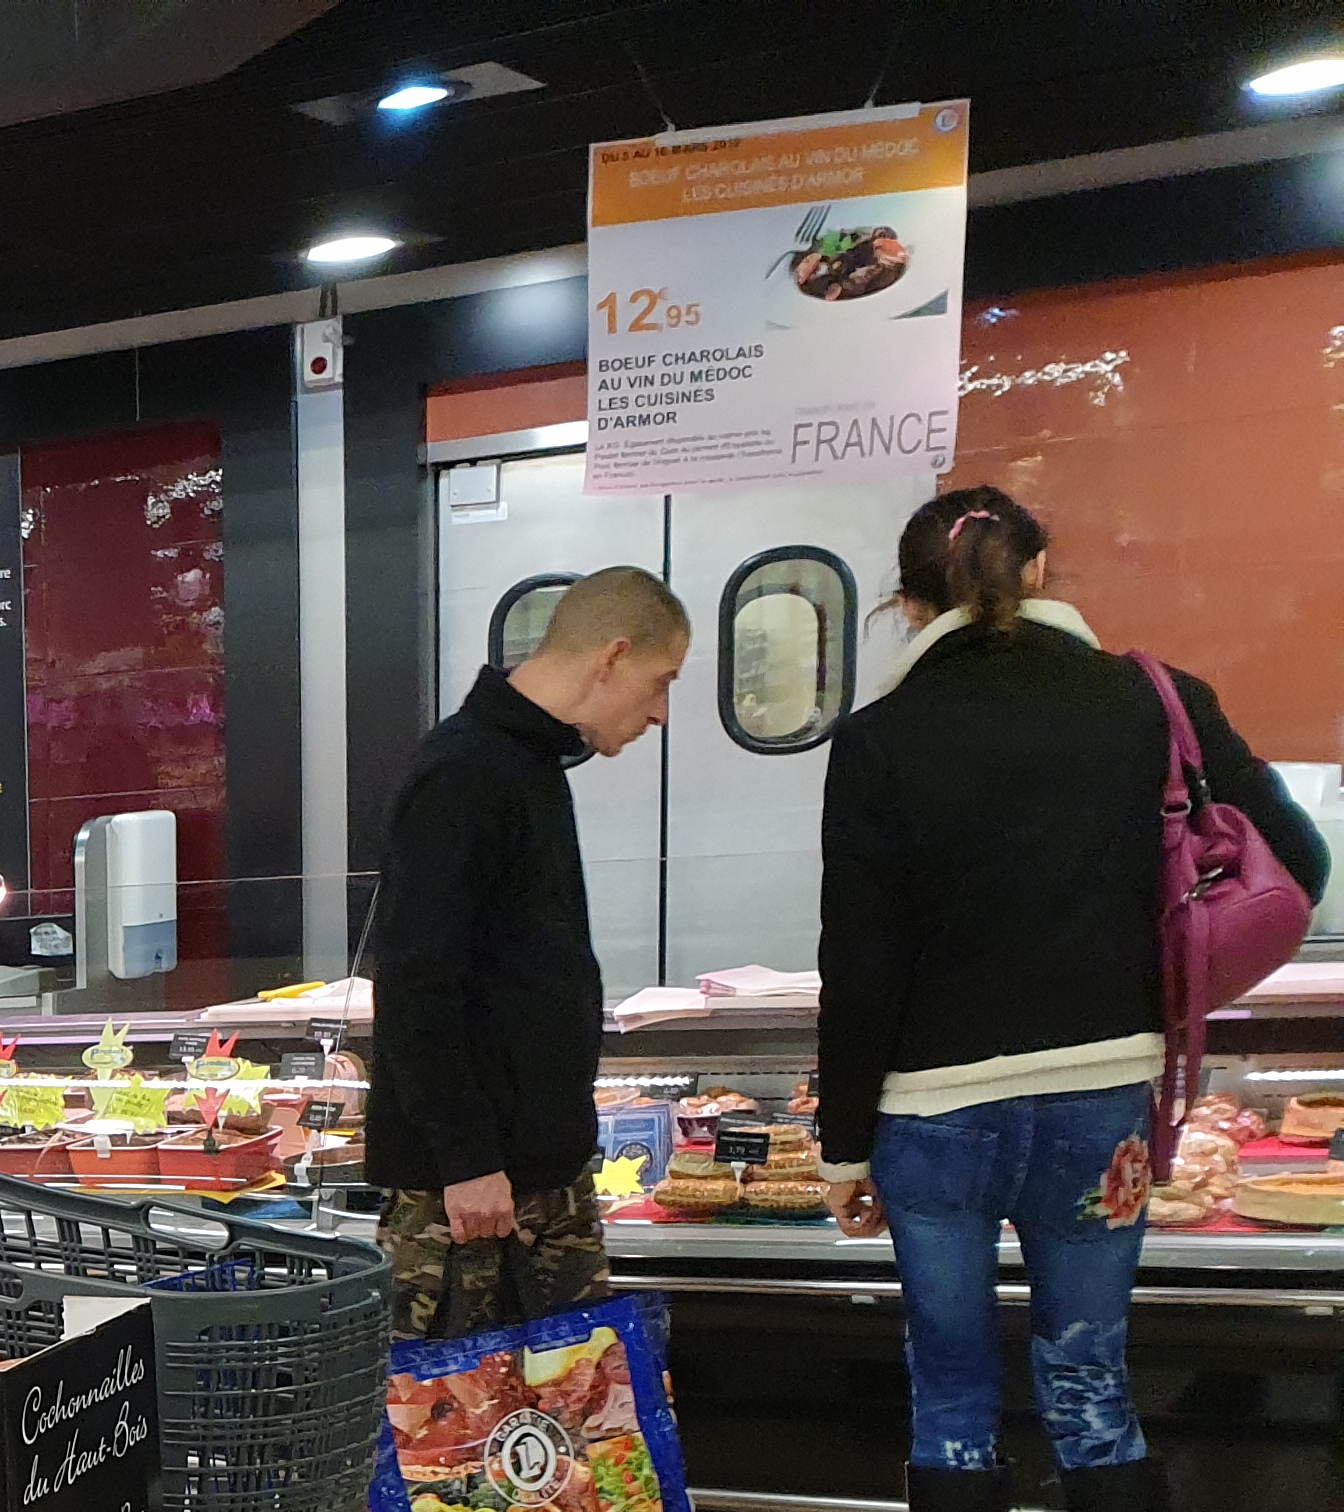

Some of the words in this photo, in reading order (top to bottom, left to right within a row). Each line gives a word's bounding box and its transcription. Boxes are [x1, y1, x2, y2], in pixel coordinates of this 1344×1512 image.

[599, 354, 656, 372] BOEUF
[662, 344, 765, 367] CHAROLAIS
[597, 373, 622, 392] AU
[627, 370, 656, 389] VIN
[659, 368, 685, 386] DU
[597, 394, 629, 411] LES
[597, 411, 678, 431] D'ARMOR
[790, 410, 949, 464] FRANCE
[22, 1344, 145, 1445] Cochonnailles
[23, 1455, 50, 1505] du
[54, 1400, 148, 1493] Haut-Bois
